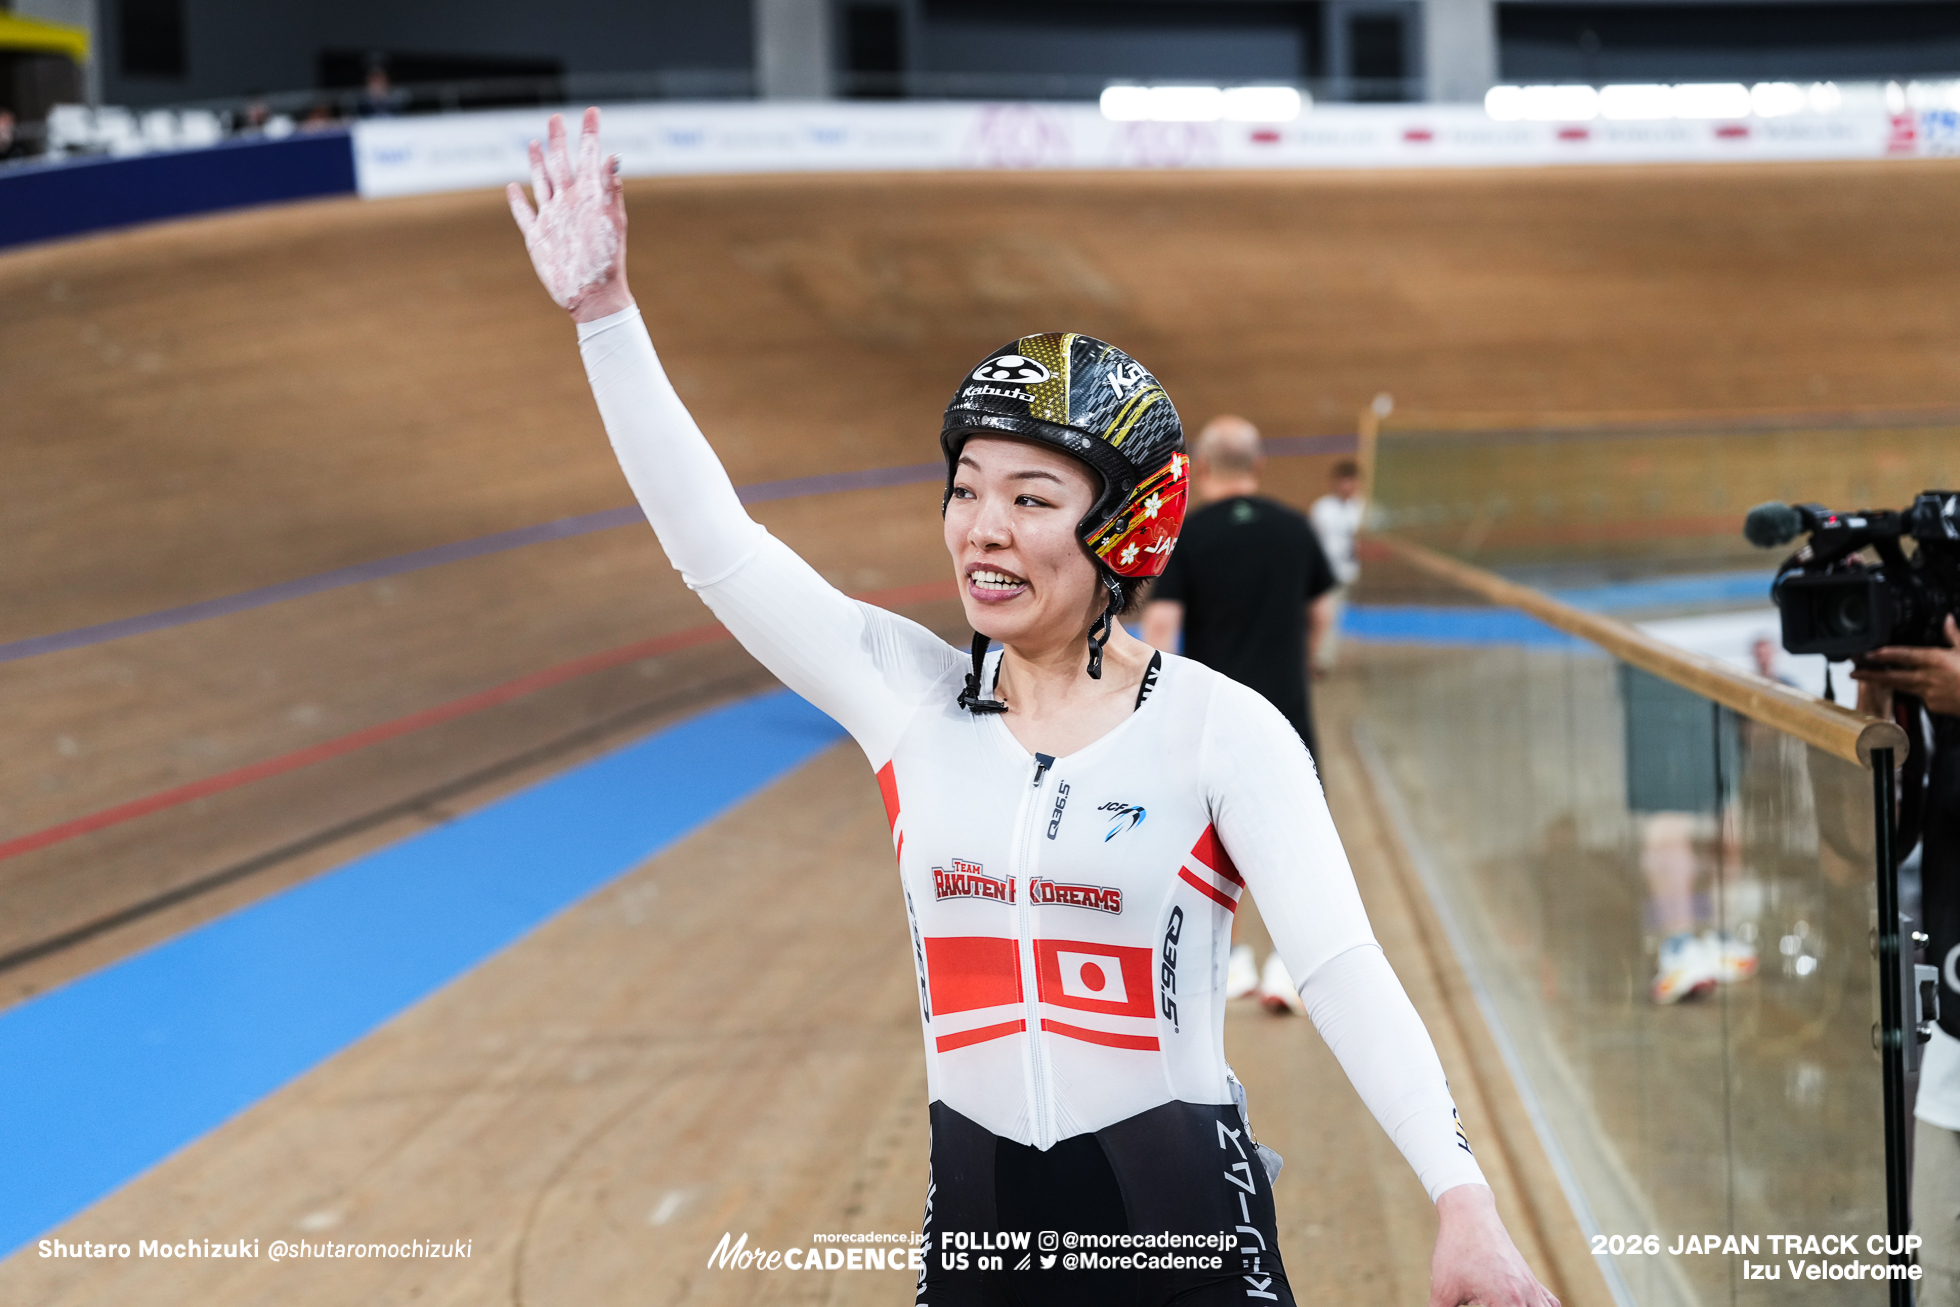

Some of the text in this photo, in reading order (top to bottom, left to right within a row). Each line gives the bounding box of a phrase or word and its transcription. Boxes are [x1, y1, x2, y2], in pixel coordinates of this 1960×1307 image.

[1097, 801, 1129, 812] JCF
[953, 860, 982, 875] TEAM
[932, 868, 1007, 903] RAKUTEN
[1039, 881, 1122, 914] DREAMS
